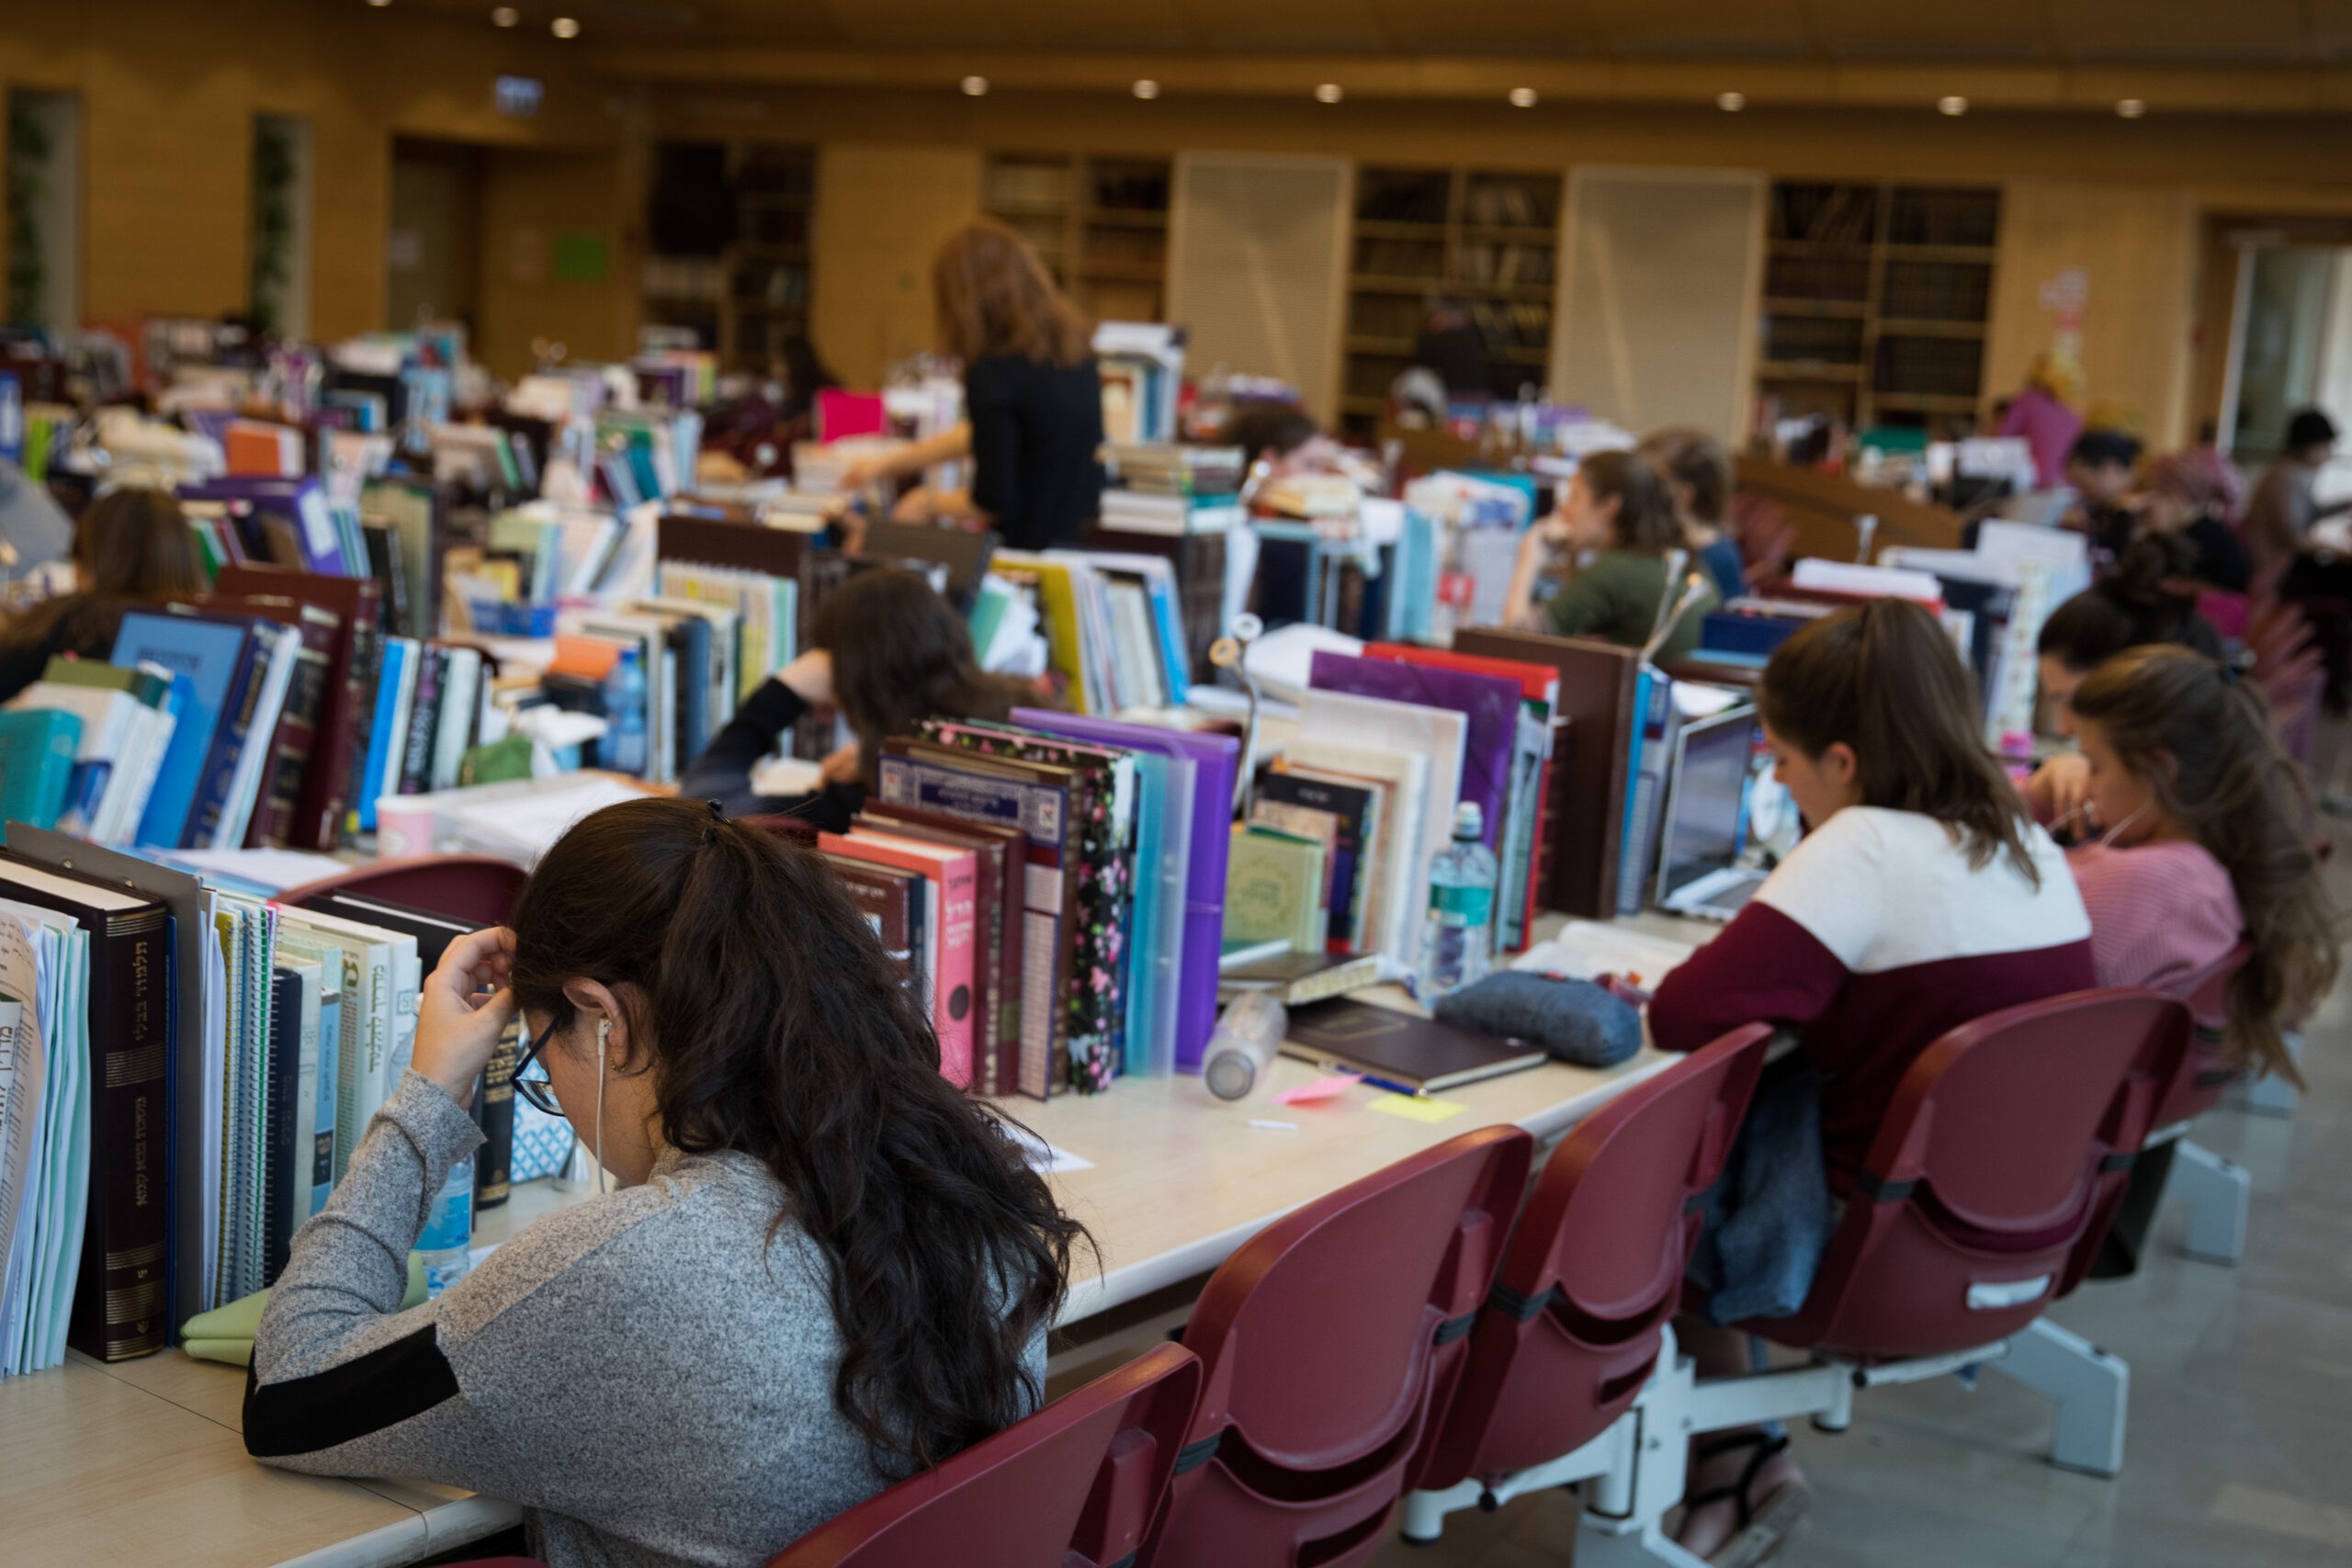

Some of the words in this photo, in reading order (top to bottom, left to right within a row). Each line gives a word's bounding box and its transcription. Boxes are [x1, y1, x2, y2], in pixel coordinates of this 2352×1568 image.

[132, 942, 148, 997] תלמוד
[132, 1000, 148, 1042] בבלי
[134, 1095, 147, 1139] מסכת
[135, 1141, 147, 1170] בבא
[135, 1173, 152, 1206] קמא
